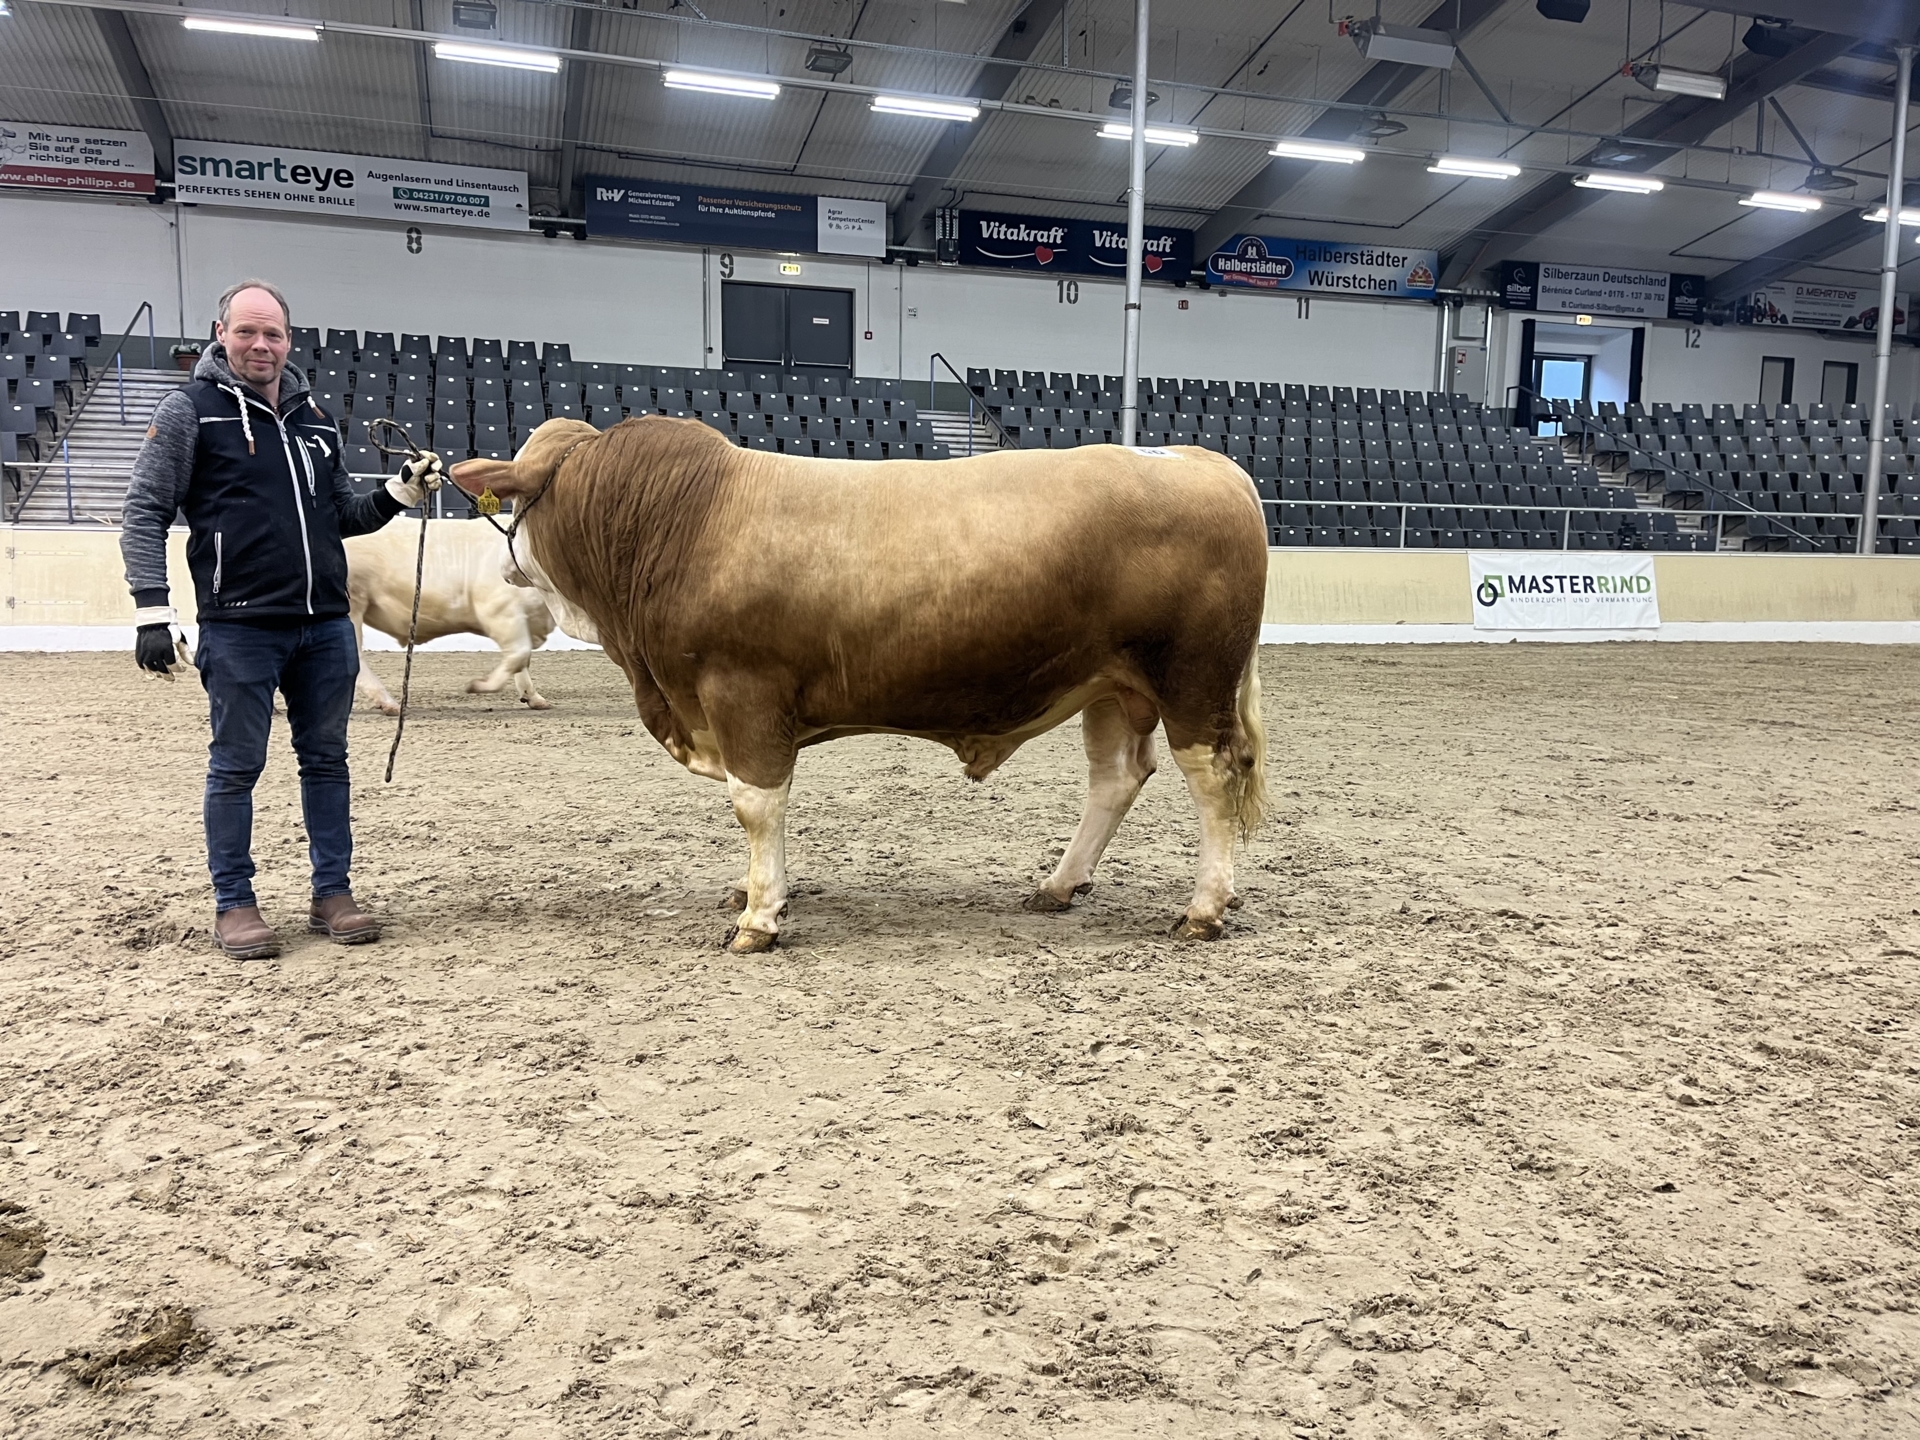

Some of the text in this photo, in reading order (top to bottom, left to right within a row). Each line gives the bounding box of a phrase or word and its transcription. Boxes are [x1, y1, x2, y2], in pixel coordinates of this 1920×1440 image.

[28, 132, 128, 148] Mit uns setzen
[28, 142, 102, 156] Sie auf das
[28, 154, 80, 165] richtige
[84, 156, 120, 167] Pferd
[178, 154, 354, 192] smarteye
[366, 170, 520, 193] Augenlasern und Linsentausch
[178, 184, 356, 206] PERFEKTES SEHEN OHNE BRILLE
[412, 191, 454, 202] 04231/97
[470, 197, 485, 205] 007
[596, 187, 626, 202] R+V
[628, 190, 680, 202] Generalvertretung
[698, 195, 802, 212] Passender Versicherungsschutz
[394, 202, 490, 218] www.smarteye.de
[724, 207, 776, 218] Auktionspferde
[827, 215, 876, 225] KompetenzCenter
[406, 226, 422, 254] 8
[980, 220, 1064, 244] Vitakraft
[1092, 230, 1173, 253] Vitaraft
[719, 253, 734, 278] 9
[1294, 244, 1408, 268] Halberstädter
[1218, 257, 1287, 275] Halberstädter
[1308, 268, 1398, 292] Würstchen
[1543, 267, 1667, 287] Silberzaun Deutschland
[1056, 280, 1079, 305] 10
[1506, 283, 1532, 293] silber
[1542, 285, 1572, 295] Bérénice
[1574, 288, 1602, 297] Curland
[1796, 286, 1858, 300] D. MEHRTENS
[1297, 297, 1310, 320] 11
[1684, 328, 1700, 349] 12
[1508, 574, 1651, 594] MASTERRIND
